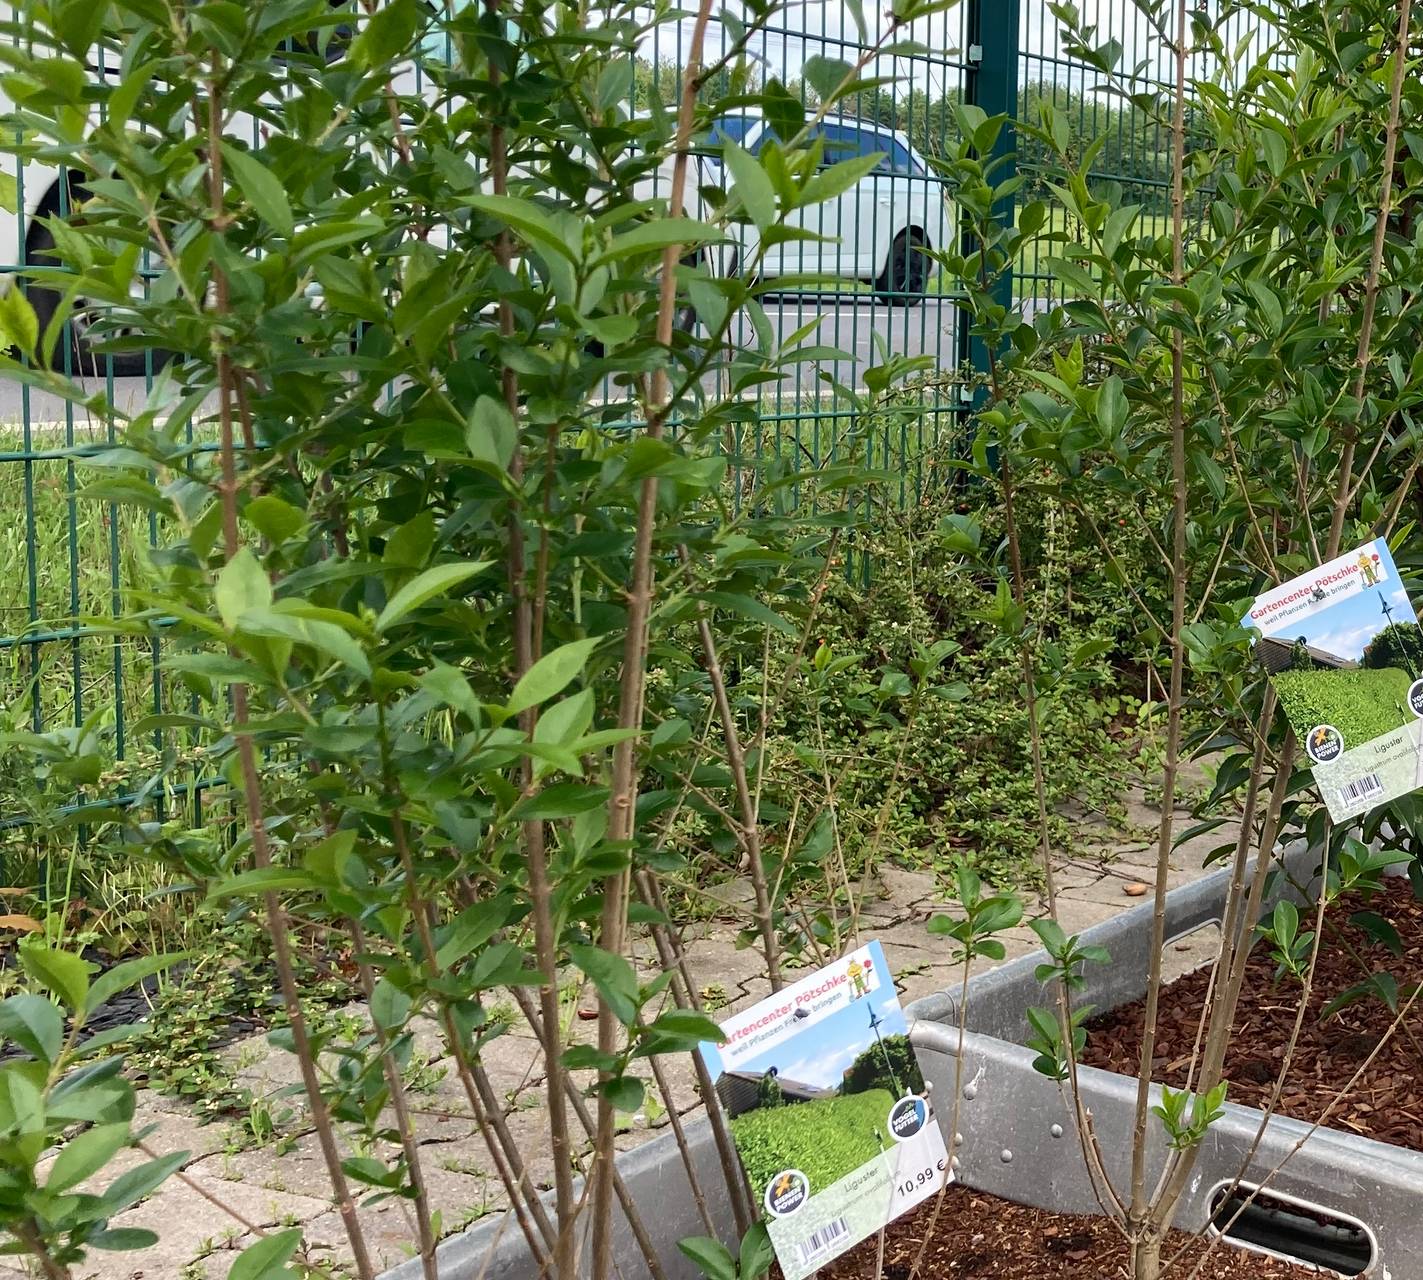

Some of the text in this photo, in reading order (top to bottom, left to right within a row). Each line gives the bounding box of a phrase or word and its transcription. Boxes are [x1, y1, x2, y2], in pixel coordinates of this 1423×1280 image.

[1250, 563, 1359, 620] Gartencenter Pötschke
[1314, 740, 1337, 753] BIENEN
[1316, 746, 1339, 759] POWER
[1373, 736, 1404, 754] Liguster
[795, 973, 847, 1007] Pötschke
[892, 1109, 916, 1126] VOGEL
[894, 1115, 919, 1133] FUTTER
[843, 1167, 879, 1193] Liguster
[897, 1168, 934, 1197] 10,99
[936, 1159, 947, 1171] €
[775, 1192, 804, 1213] POWER
